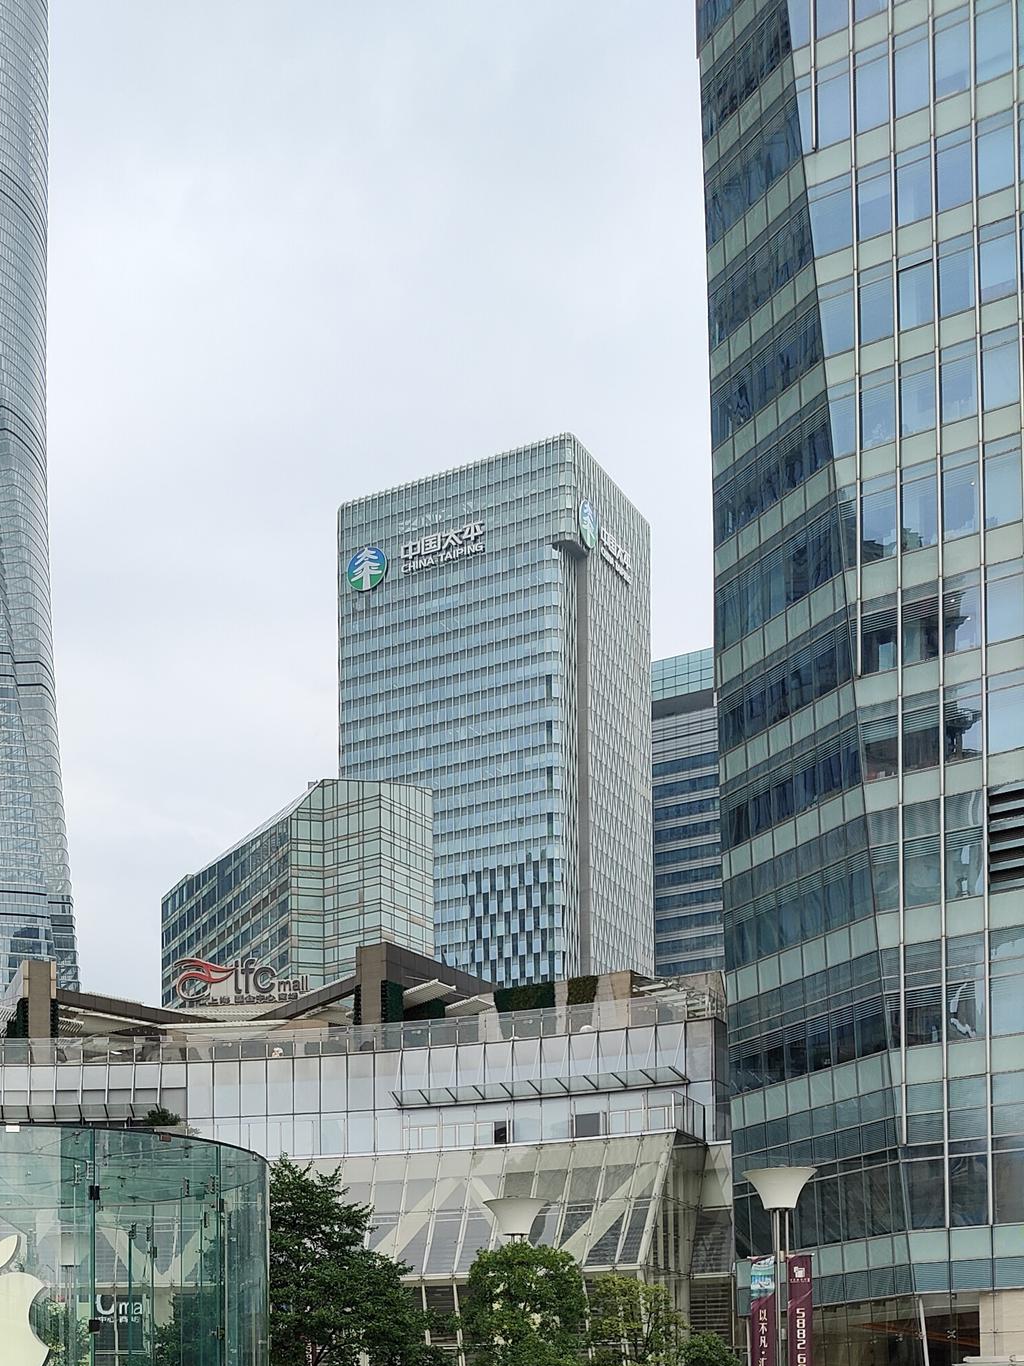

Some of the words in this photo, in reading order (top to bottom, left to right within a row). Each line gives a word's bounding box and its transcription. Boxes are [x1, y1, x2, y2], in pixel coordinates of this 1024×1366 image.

[401, 521, 484, 559] 中国太平
[401, 557, 434, 573] CHINA
[438, 543, 484, 562] TAIPING
[234, 959, 276, 993] ifc
[278, 975, 309, 992] mall
[796, 1308, 806, 1349] 5882
